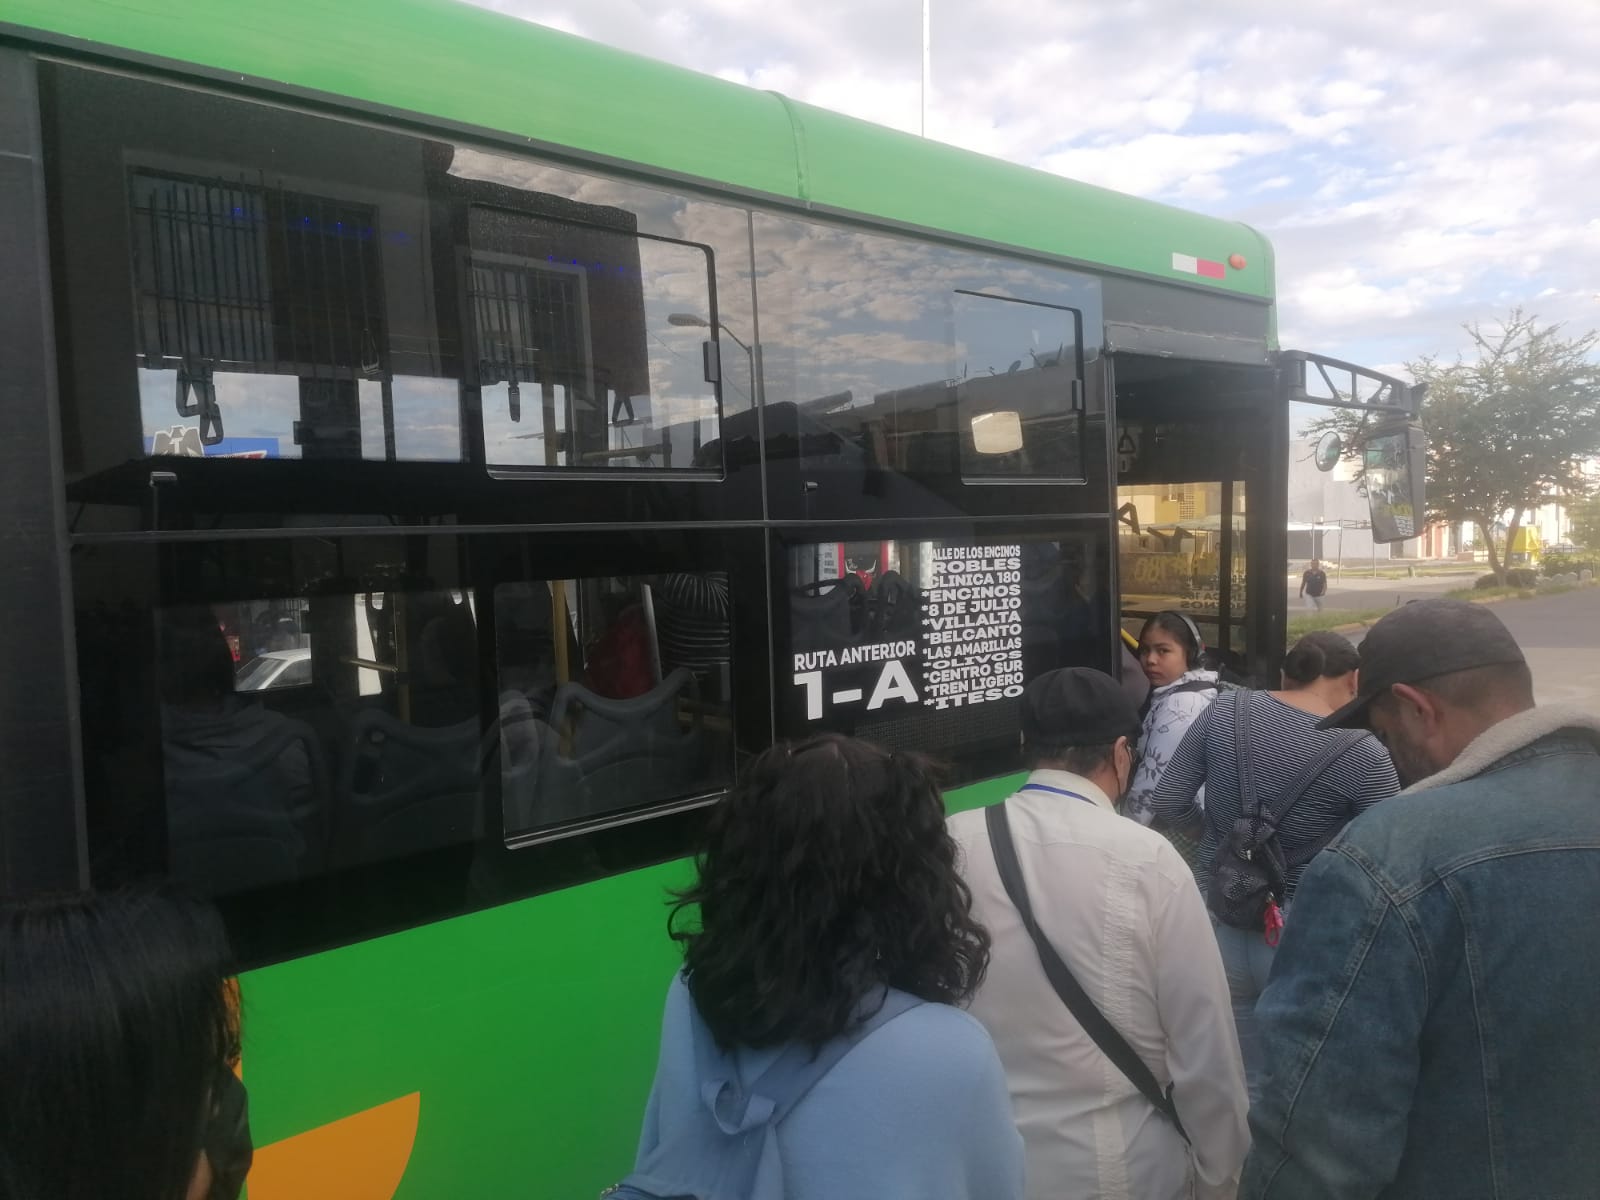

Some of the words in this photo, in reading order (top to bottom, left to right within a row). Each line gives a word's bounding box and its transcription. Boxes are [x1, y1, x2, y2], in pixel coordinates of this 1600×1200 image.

[927, 548, 953, 561] ALLE
[953, 547, 966, 560] DE
[966, 546, 983, 559] LOS
[984, 545, 1021, 558] ENCINOS
[931, 558, 1021, 574] ROBLES
[929, 572, 994, 588] CLINICA
[997, 571, 1021, 584] 180
[943, 601, 966, 615] DE
[969, 597, 1022, 613] JULIO
[794, 650, 838, 671] RUTA
[840, 640, 916, 666] ANTERIOR
[954, 637, 1022, 657] AMARILLAS
[994, 659, 1023, 674] SUR
[793, 660, 919, 720] 1-A
[971, 672, 1024, 691] LIGERO
